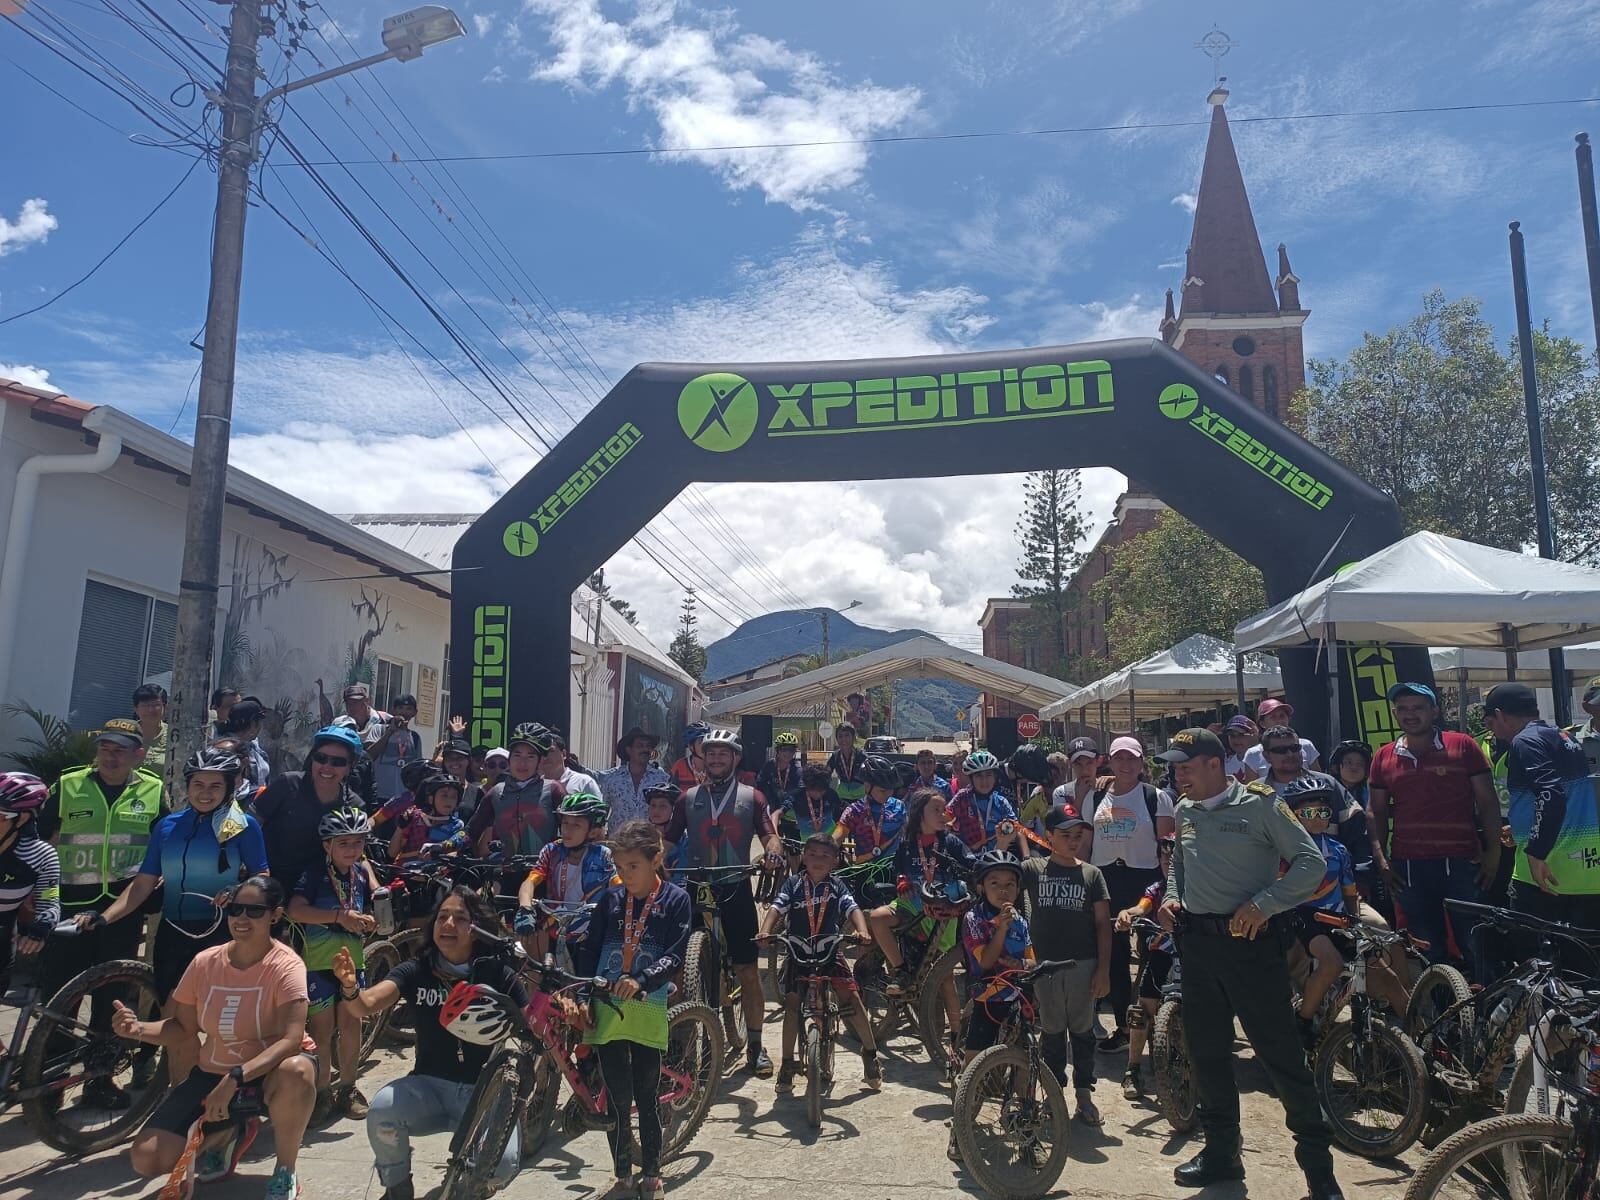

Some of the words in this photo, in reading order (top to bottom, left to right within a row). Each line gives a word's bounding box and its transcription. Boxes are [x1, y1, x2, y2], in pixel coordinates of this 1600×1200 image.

[1018, 722, 1039, 730] PARE
[1038, 882, 1086, 901] OUTSIDE
[1038, 897, 1054, 908] STAY
